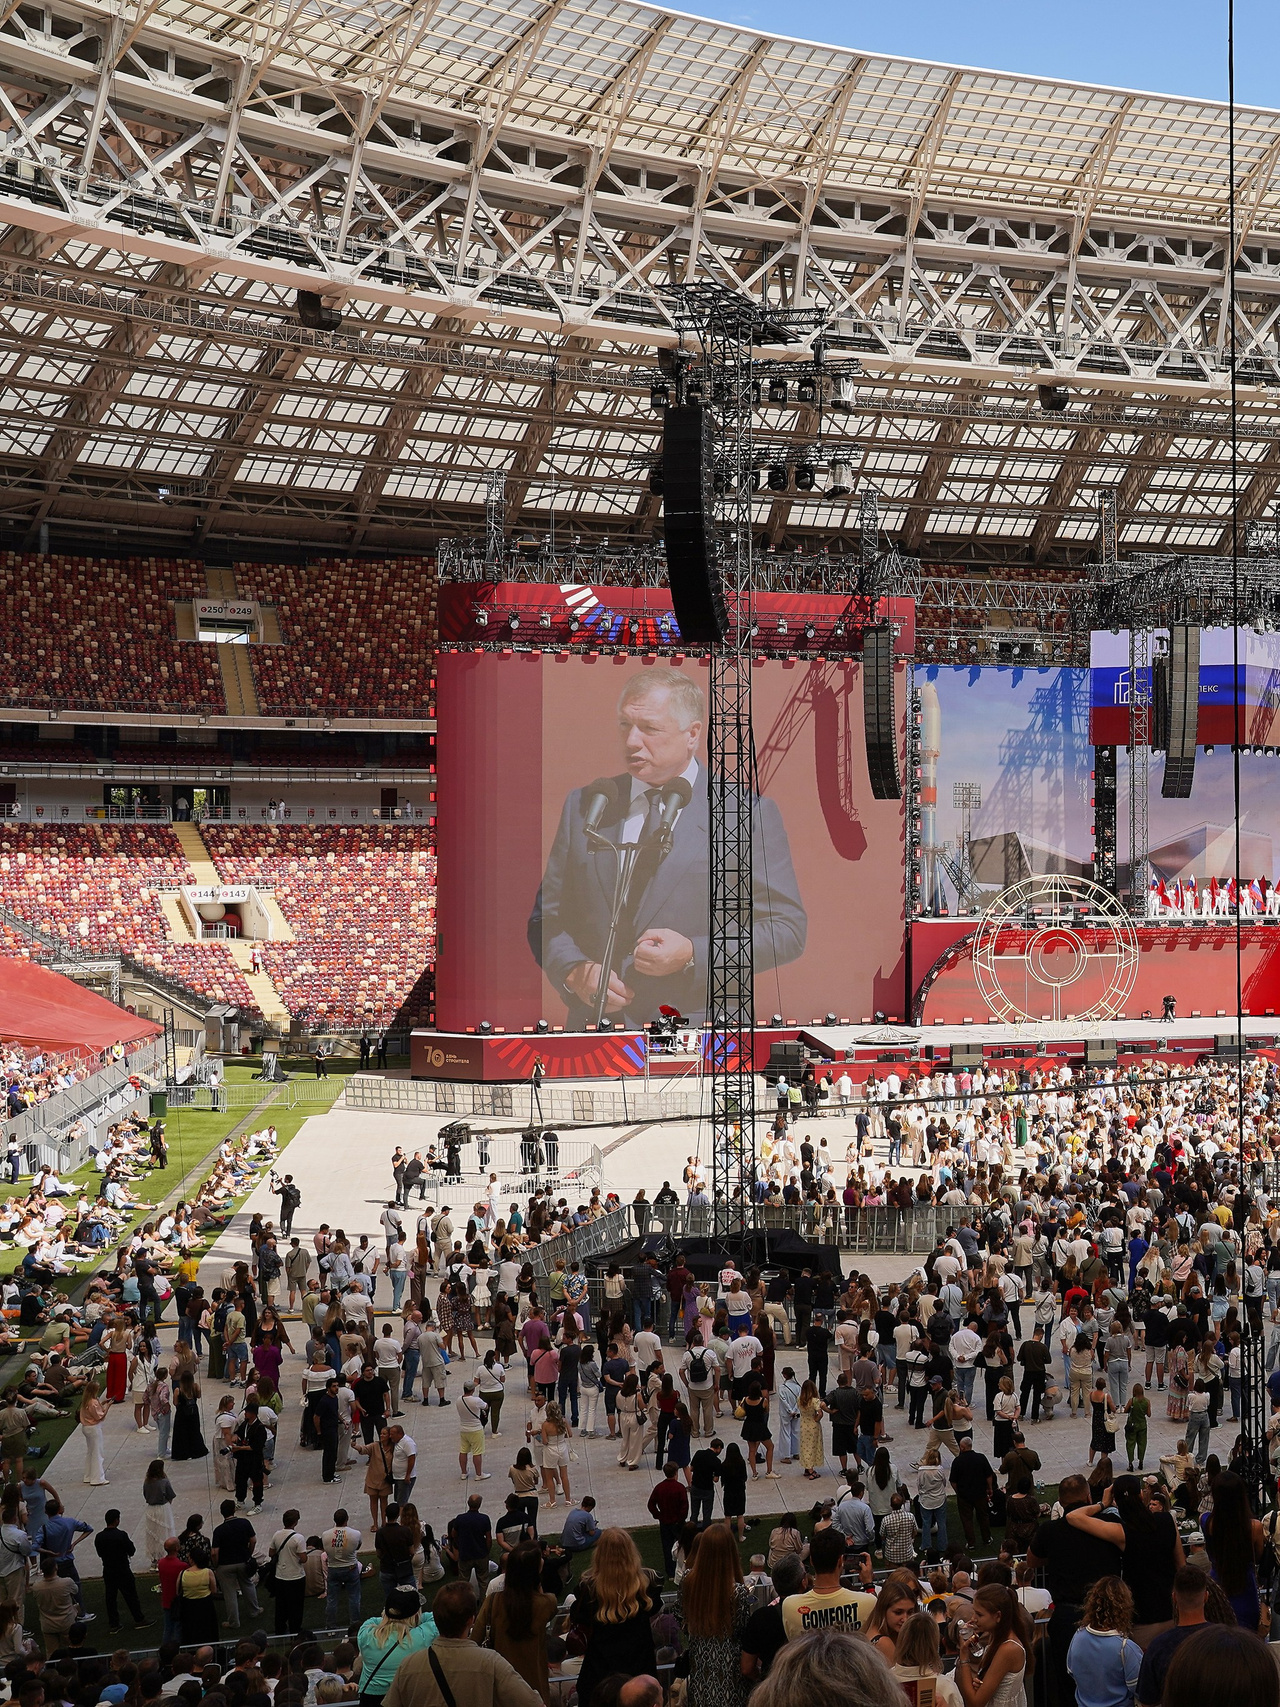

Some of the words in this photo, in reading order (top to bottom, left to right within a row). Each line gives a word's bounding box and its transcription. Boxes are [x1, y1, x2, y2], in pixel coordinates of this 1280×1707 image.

[207, 606, 223, 614] 250
[236, 607, 252, 615] 249
[198, 890, 215, 898] 144
[229, 890, 246, 898] 143
[423, 1045, 445, 1068] 70
[802, 1602, 859, 1631] COMFORT
